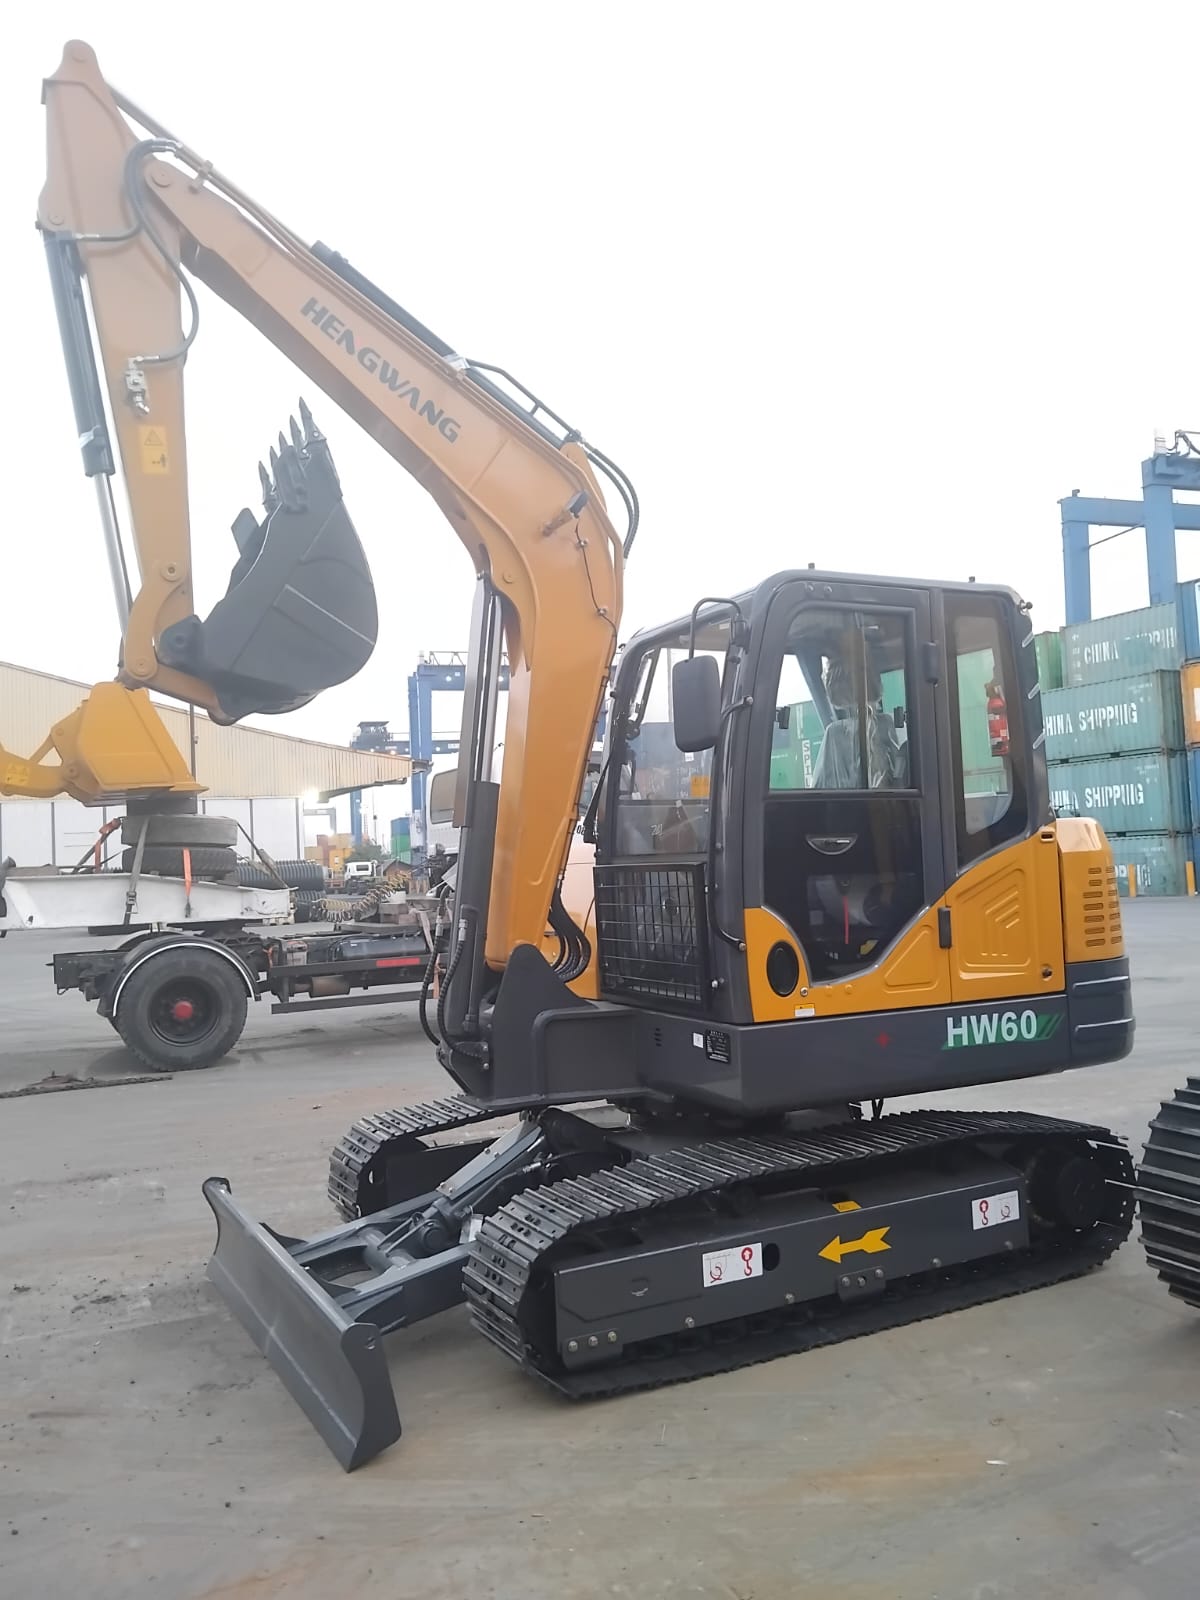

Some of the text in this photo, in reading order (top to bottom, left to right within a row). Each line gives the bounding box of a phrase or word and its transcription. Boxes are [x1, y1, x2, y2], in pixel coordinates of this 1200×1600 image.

[300, 297, 462, 444] HENGWANG
[1043, 713, 1073, 737] HINA
[946, 1009, 1038, 1048] HW60
